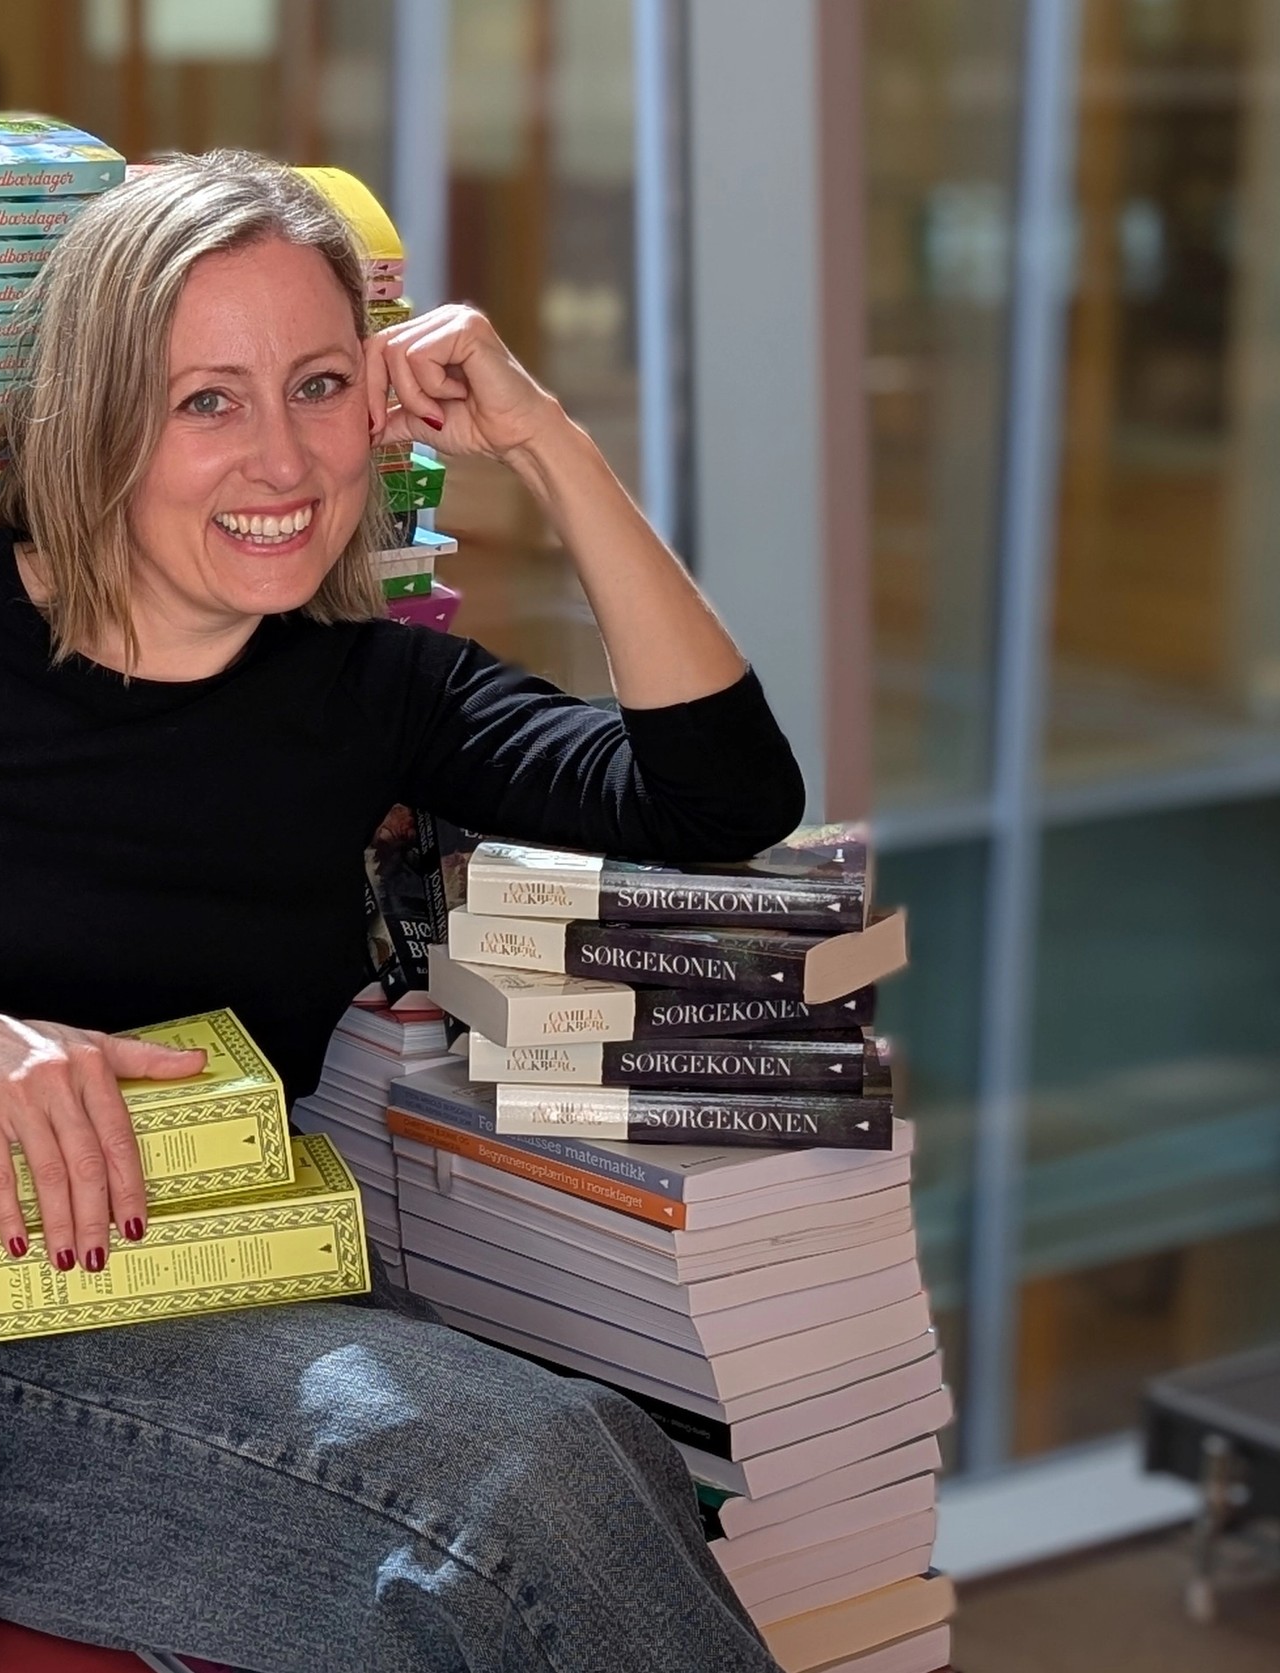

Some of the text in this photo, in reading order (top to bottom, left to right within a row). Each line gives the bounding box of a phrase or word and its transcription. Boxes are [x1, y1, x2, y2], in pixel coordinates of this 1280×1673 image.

[509, 882, 566, 894] CAMILLA
[618, 888, 789, 913] SØRGEKONEN
[485, 931, 536, 947] CAMILLA
[581, 944, 738, 981] SØRGEKONEN
[549, 1009, 603, 1022] CAMILLA
[651, 1000, 810, 1026] SØRGEKONEN
[512, 1049, 569, 1060] CAMILLA
[620, 1052, 792, 1076] SØRGEKONEN
[646, 1108, 820, 1134] SØRGEKONEN
[565, 1144, 646, 1182] matematikk
[478, 1145, 579, 1191] Begynneropplæring
[587, 1182, 642, 1208] norskfaget
[9, 1267, 23, 1310] OLGA
[39, 1261, 57, 1306] JAKOBS
[56, 1270, 69, 1305] BØKEN
